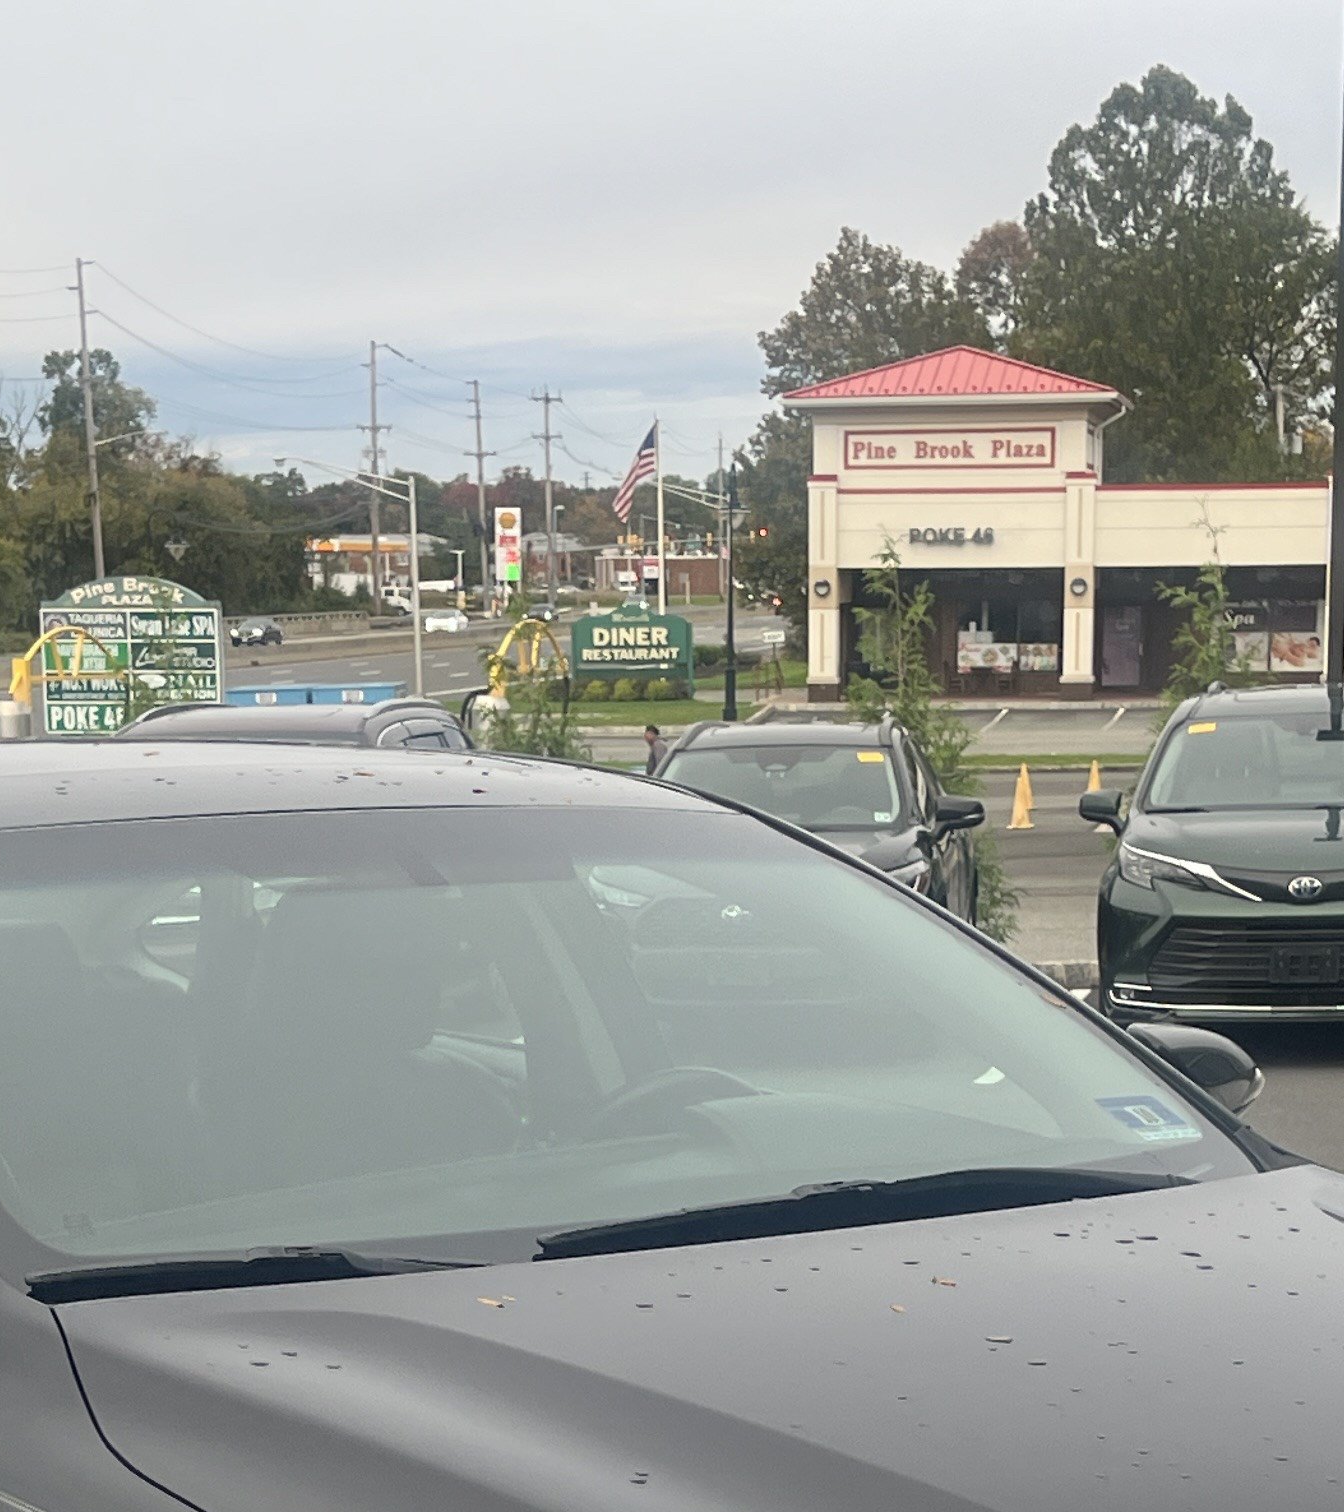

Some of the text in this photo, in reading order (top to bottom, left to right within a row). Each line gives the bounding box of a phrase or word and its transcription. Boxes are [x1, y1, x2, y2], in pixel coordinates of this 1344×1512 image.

[852, 439, 1046, 460] Pine Brook Plaza
[908, 527, 965, 546] POKE
[70, 582, 115, 604] Pine
[101, 594, 153, 606] PLAZA
[68, 613, 124, 625] TAQUERIA
[592, 627, 669, 647] DINER
[581, 647, 680, 661] RESTAURANT
[50, 706, 99, 730] POKE
